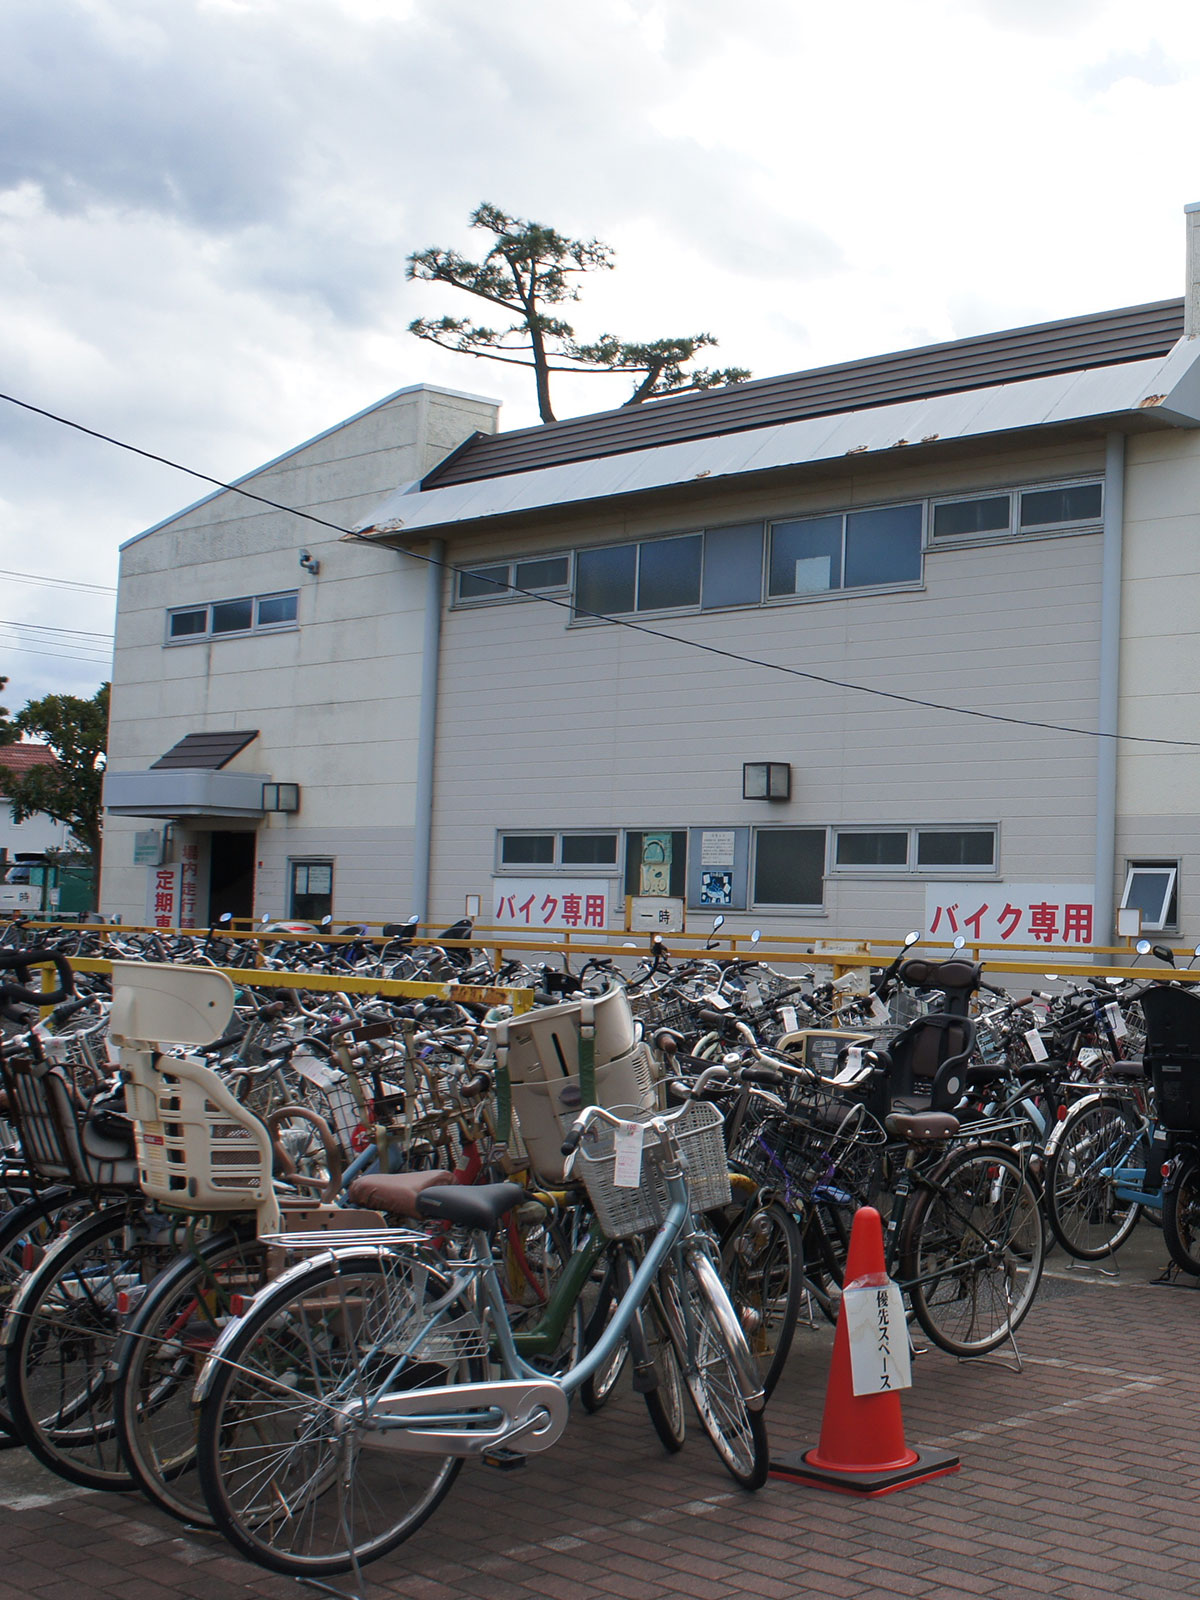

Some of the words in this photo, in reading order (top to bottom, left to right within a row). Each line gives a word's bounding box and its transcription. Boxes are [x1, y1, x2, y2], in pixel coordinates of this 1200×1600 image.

[496, 892, 605, 928] バイク専用
[641, 909, 670, 925] 一時
[929, 901, 1093, 944] バイク専用
[876, 1289, 891, 1390] 優先スペース
